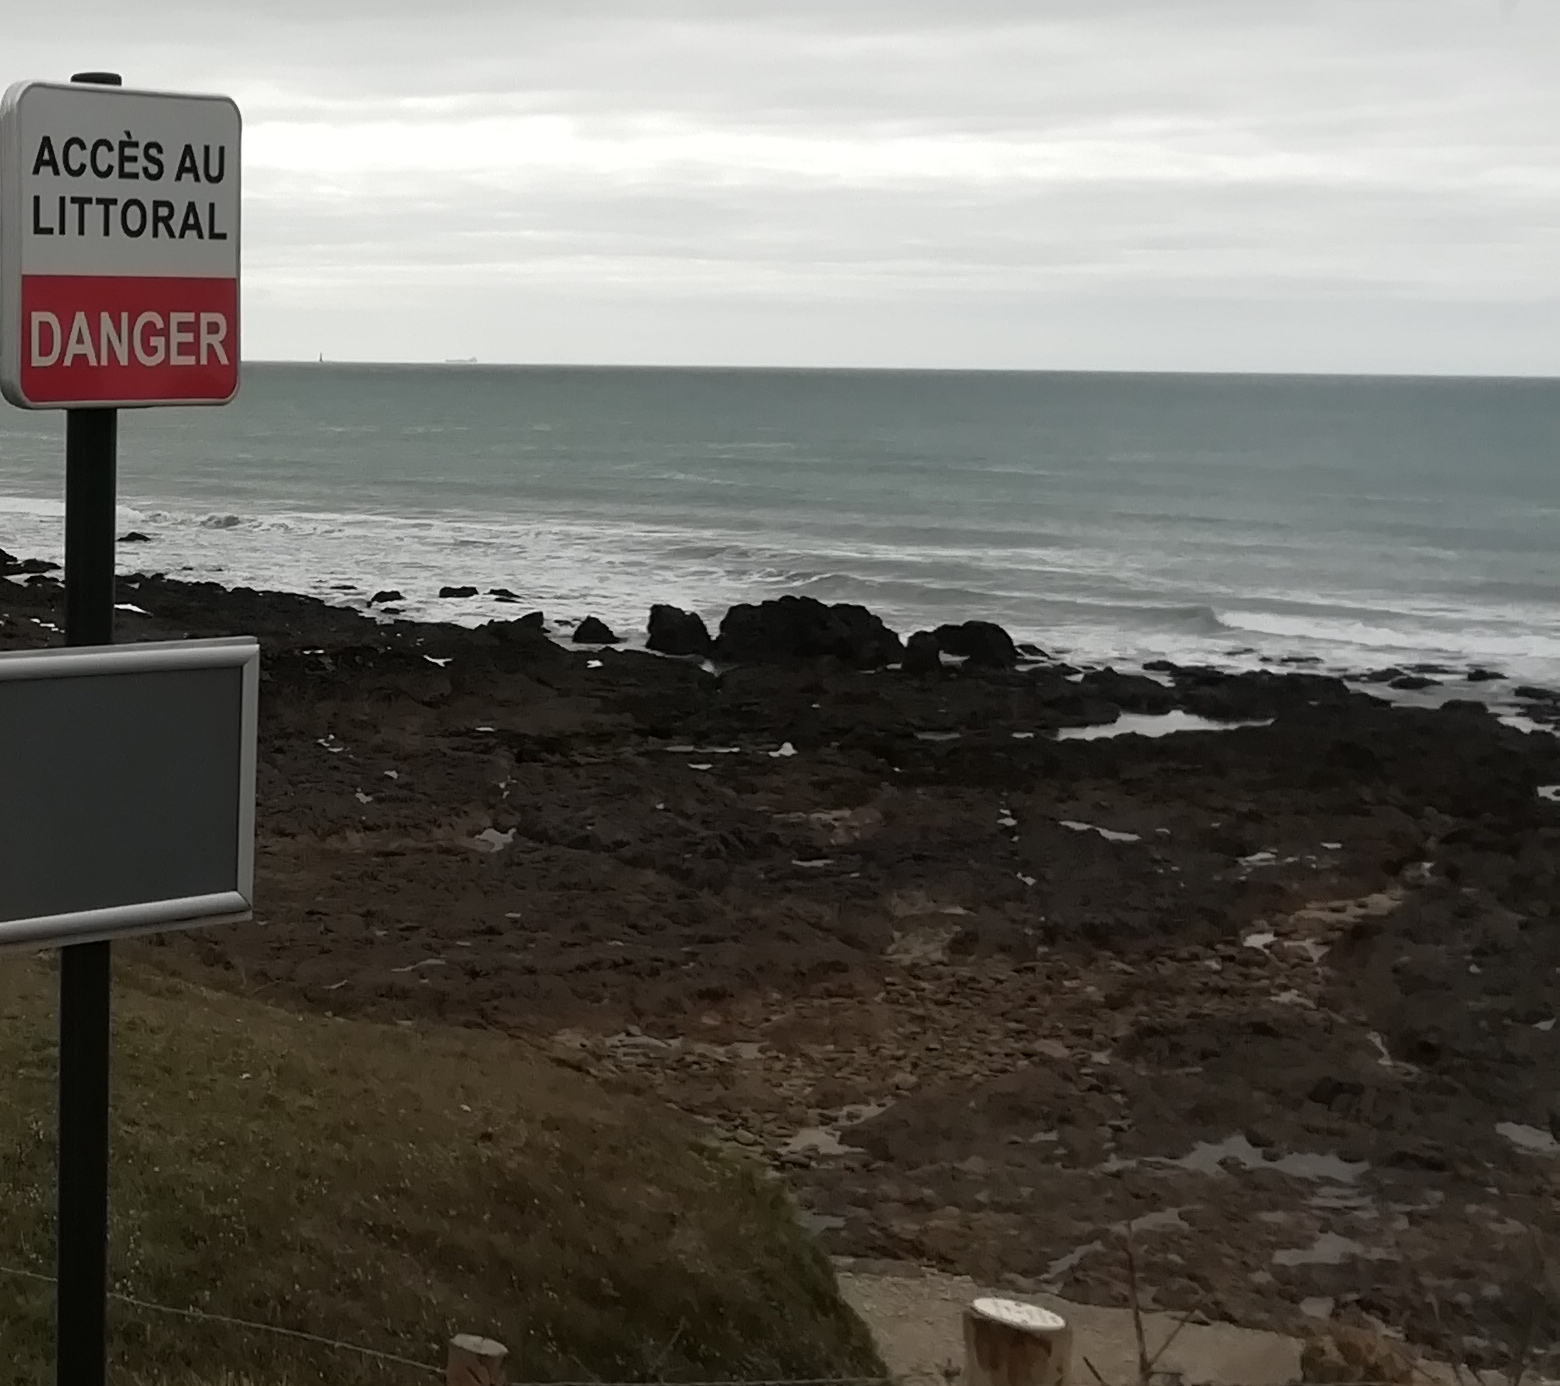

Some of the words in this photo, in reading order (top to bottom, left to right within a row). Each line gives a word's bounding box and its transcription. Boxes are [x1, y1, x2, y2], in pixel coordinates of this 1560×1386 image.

[32, 130, 165, 181] ACCÈS
[174, 144, 226, 184] AU
[33, 195, 228, 240] LITTORAL
[30, 311, 230, 367] DANGER
